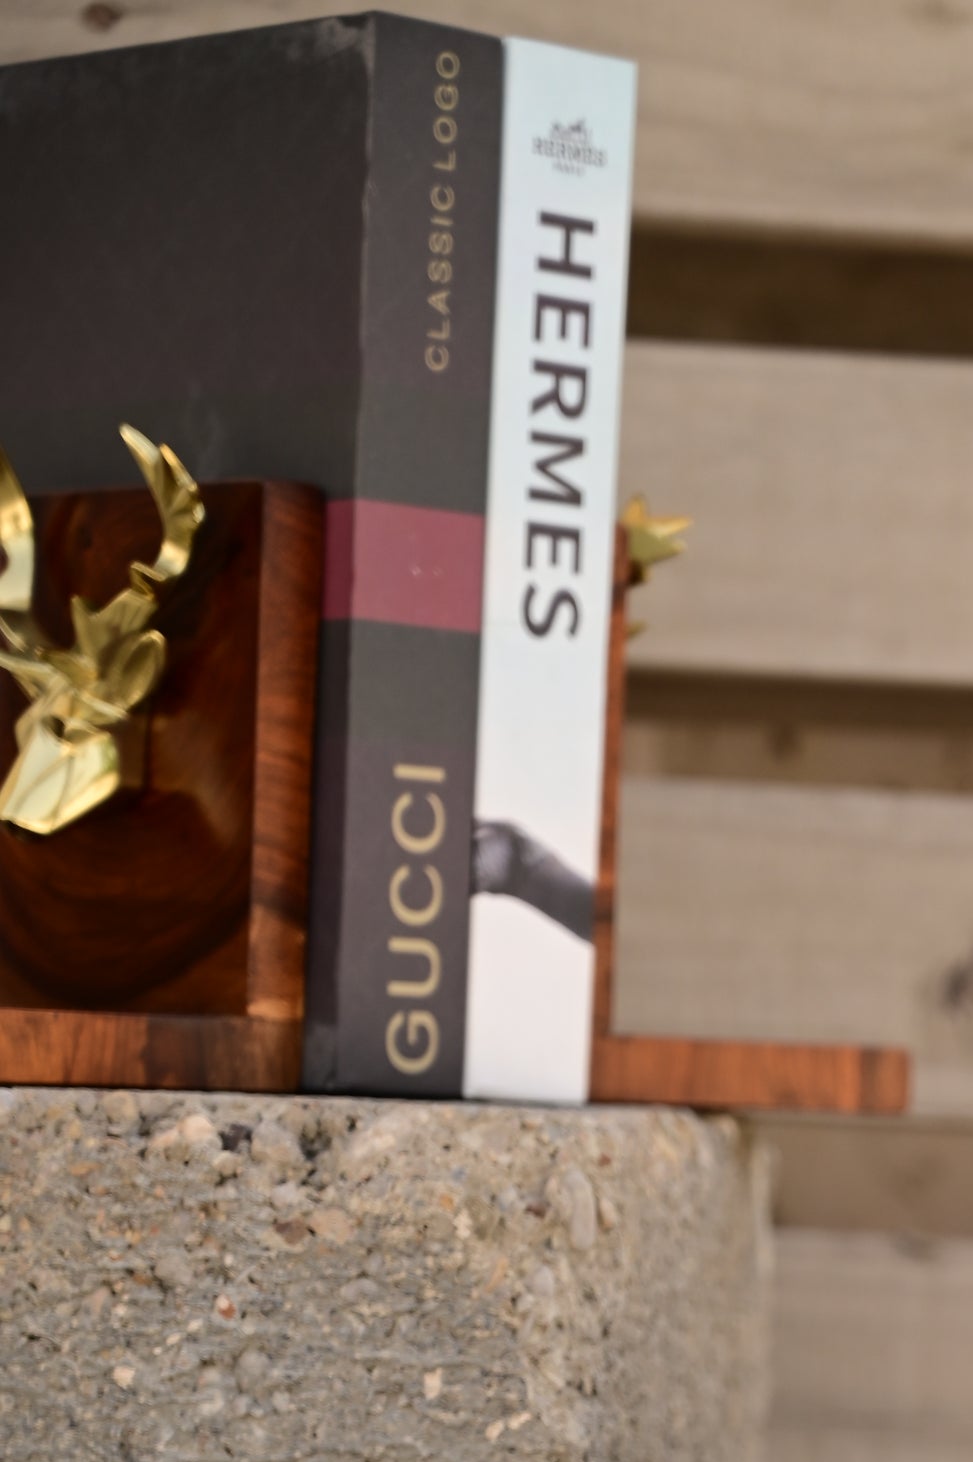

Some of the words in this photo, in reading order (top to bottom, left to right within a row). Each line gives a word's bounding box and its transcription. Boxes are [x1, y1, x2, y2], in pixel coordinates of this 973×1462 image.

[433, 51, 461, 172] LOGO
[424, 185, 456, 373] CLASSIC
[522, 210, 597, 643] HERMES
[385, 763, 446, 1075] GUCCI
